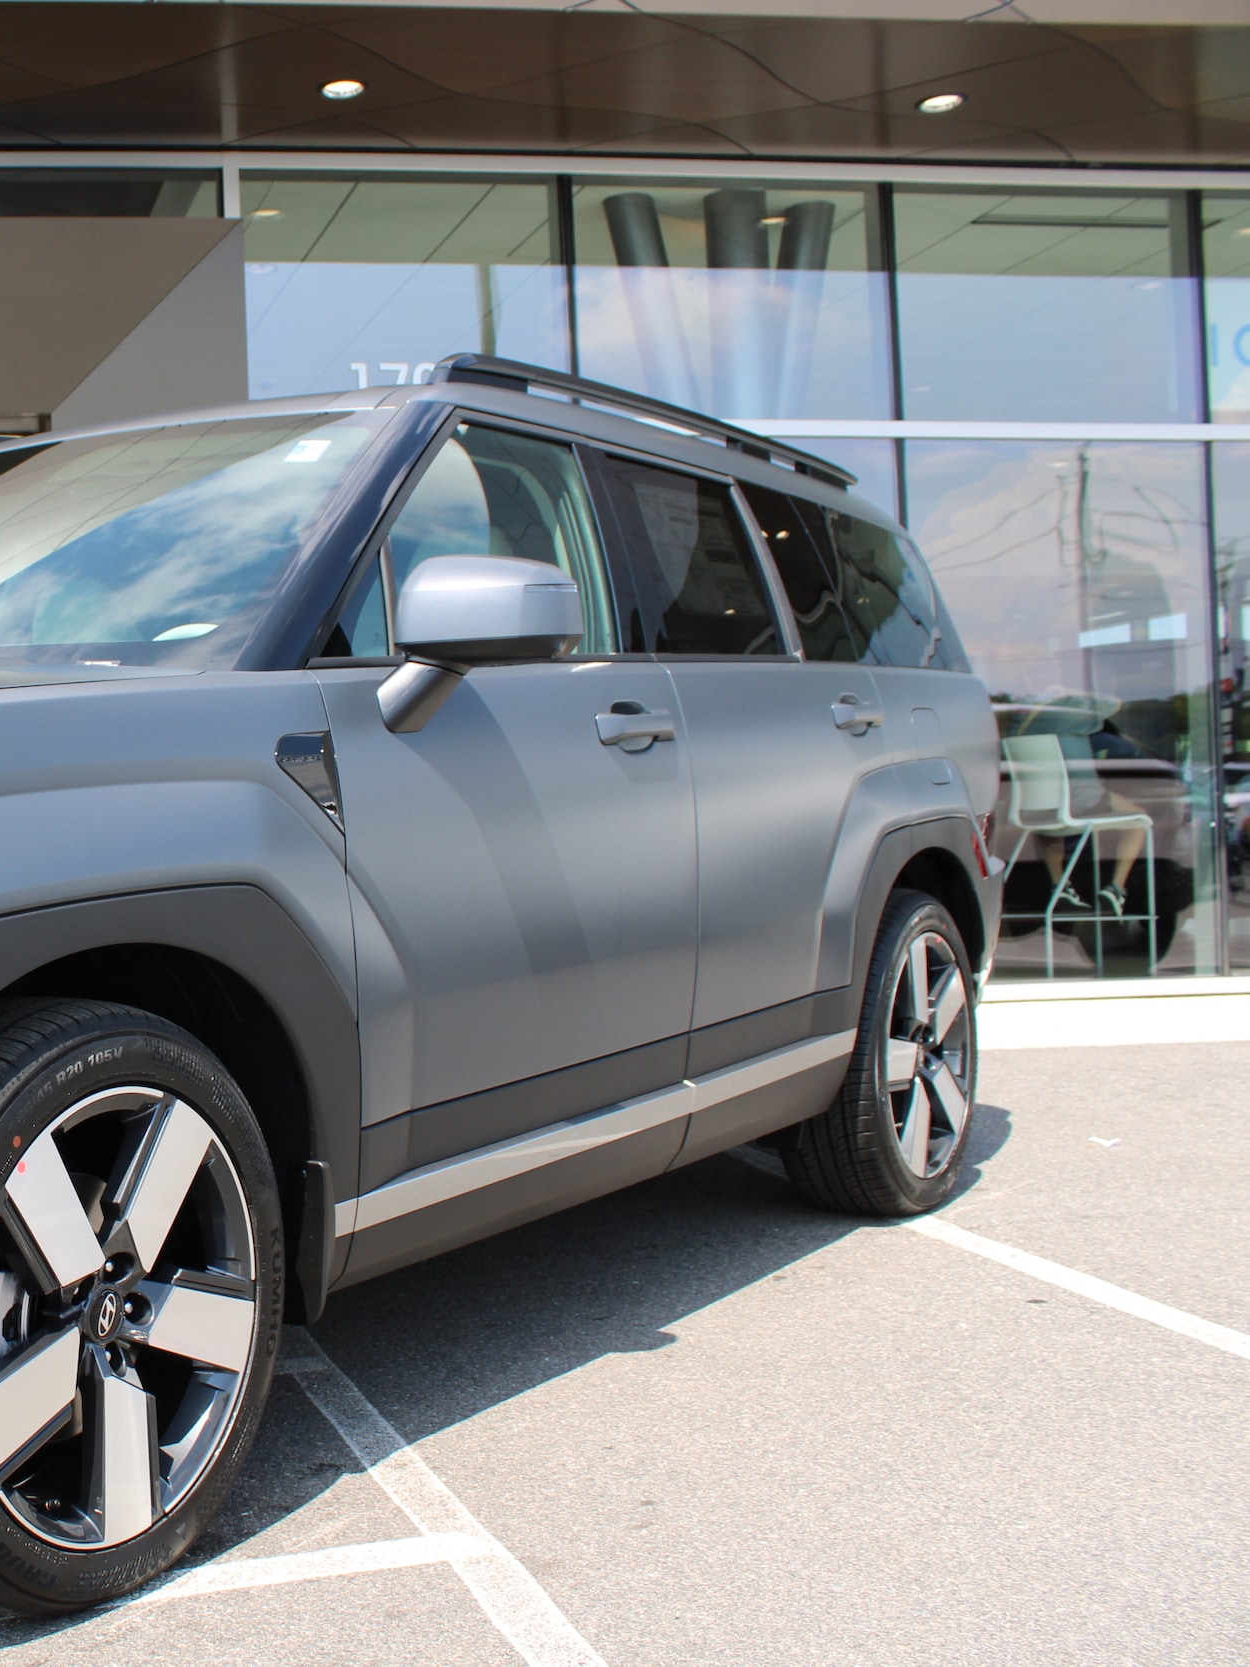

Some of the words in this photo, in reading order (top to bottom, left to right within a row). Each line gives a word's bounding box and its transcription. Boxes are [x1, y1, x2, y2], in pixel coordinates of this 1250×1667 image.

[350, 362, 436, 390] 17
[55, 1060, 84, 1087] R20
[87, 1046, 124, 1068] 105V
[266, 1228, 282, 1356] KUMHO
